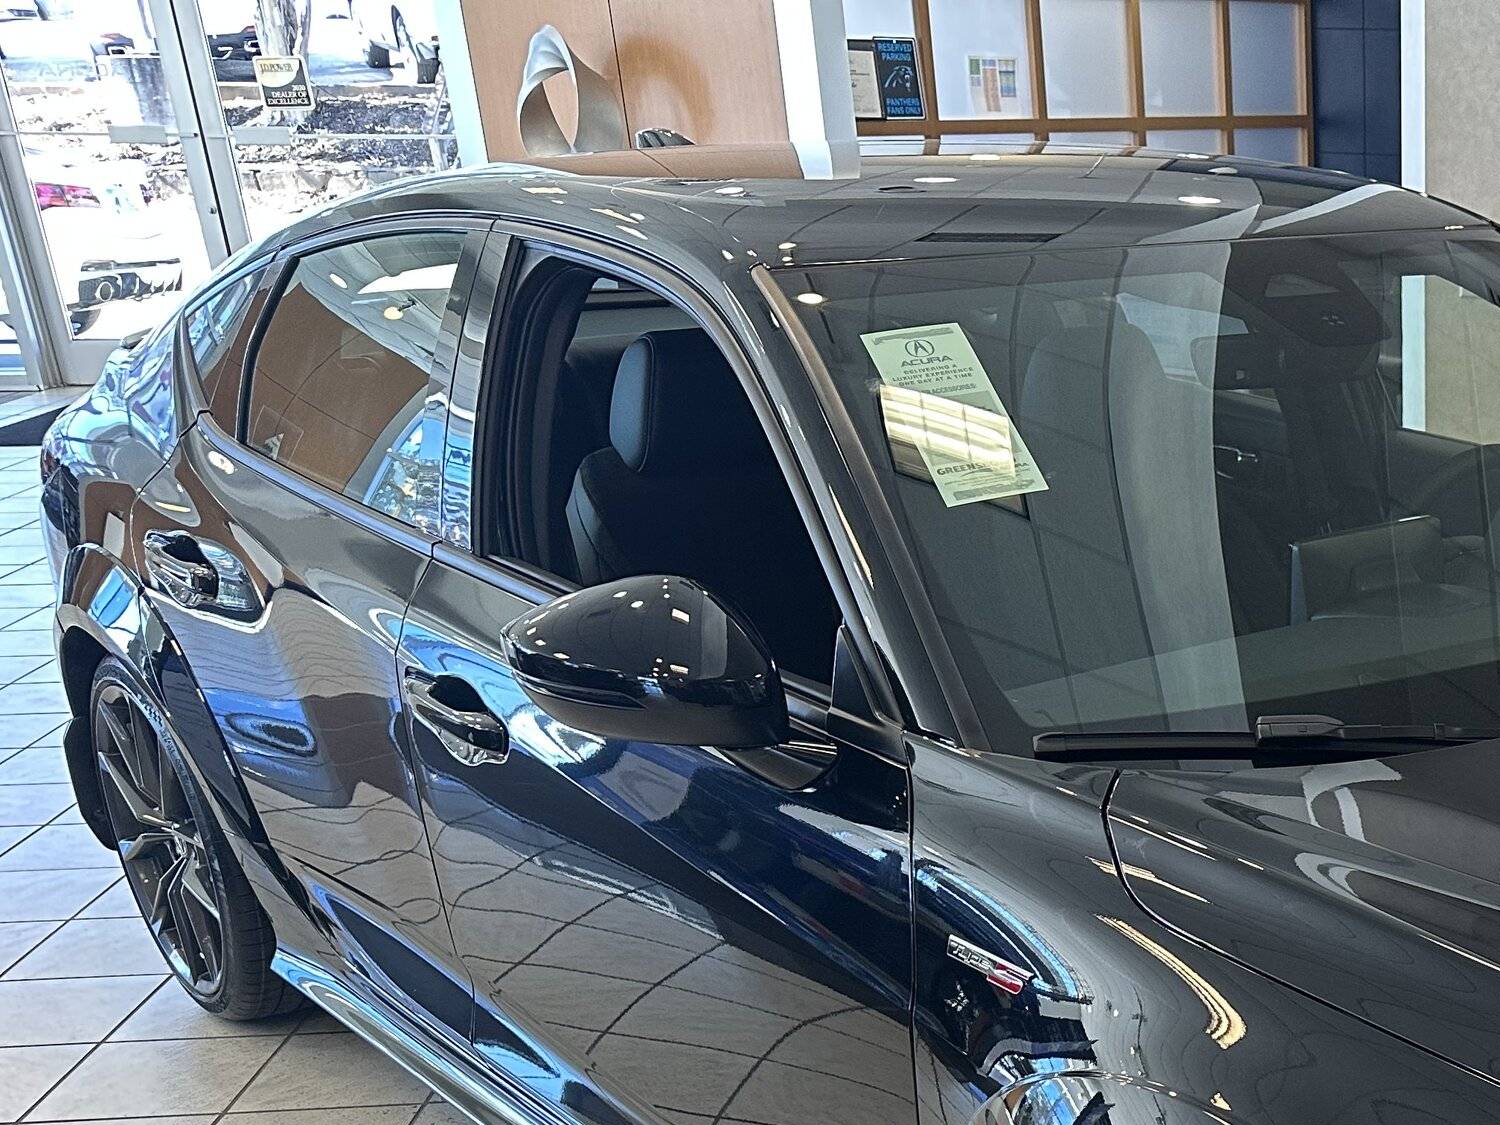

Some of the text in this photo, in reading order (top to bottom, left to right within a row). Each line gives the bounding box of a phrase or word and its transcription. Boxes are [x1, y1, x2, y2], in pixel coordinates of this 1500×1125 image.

[877, 43, 912, 52] RESERVED
[881, 52, 911, 61] PARKING
[886, 97, 920, 106] PANTHERS
[887, 106, 922, 115] FANS ONLY
[900, 355, 953, 367] ACURA
[892, 366, 974, 382] LUXURY EXPERIENCE
[903, 364, 950, 375] DELIVERING
[949, 940, 991, 971] Type
